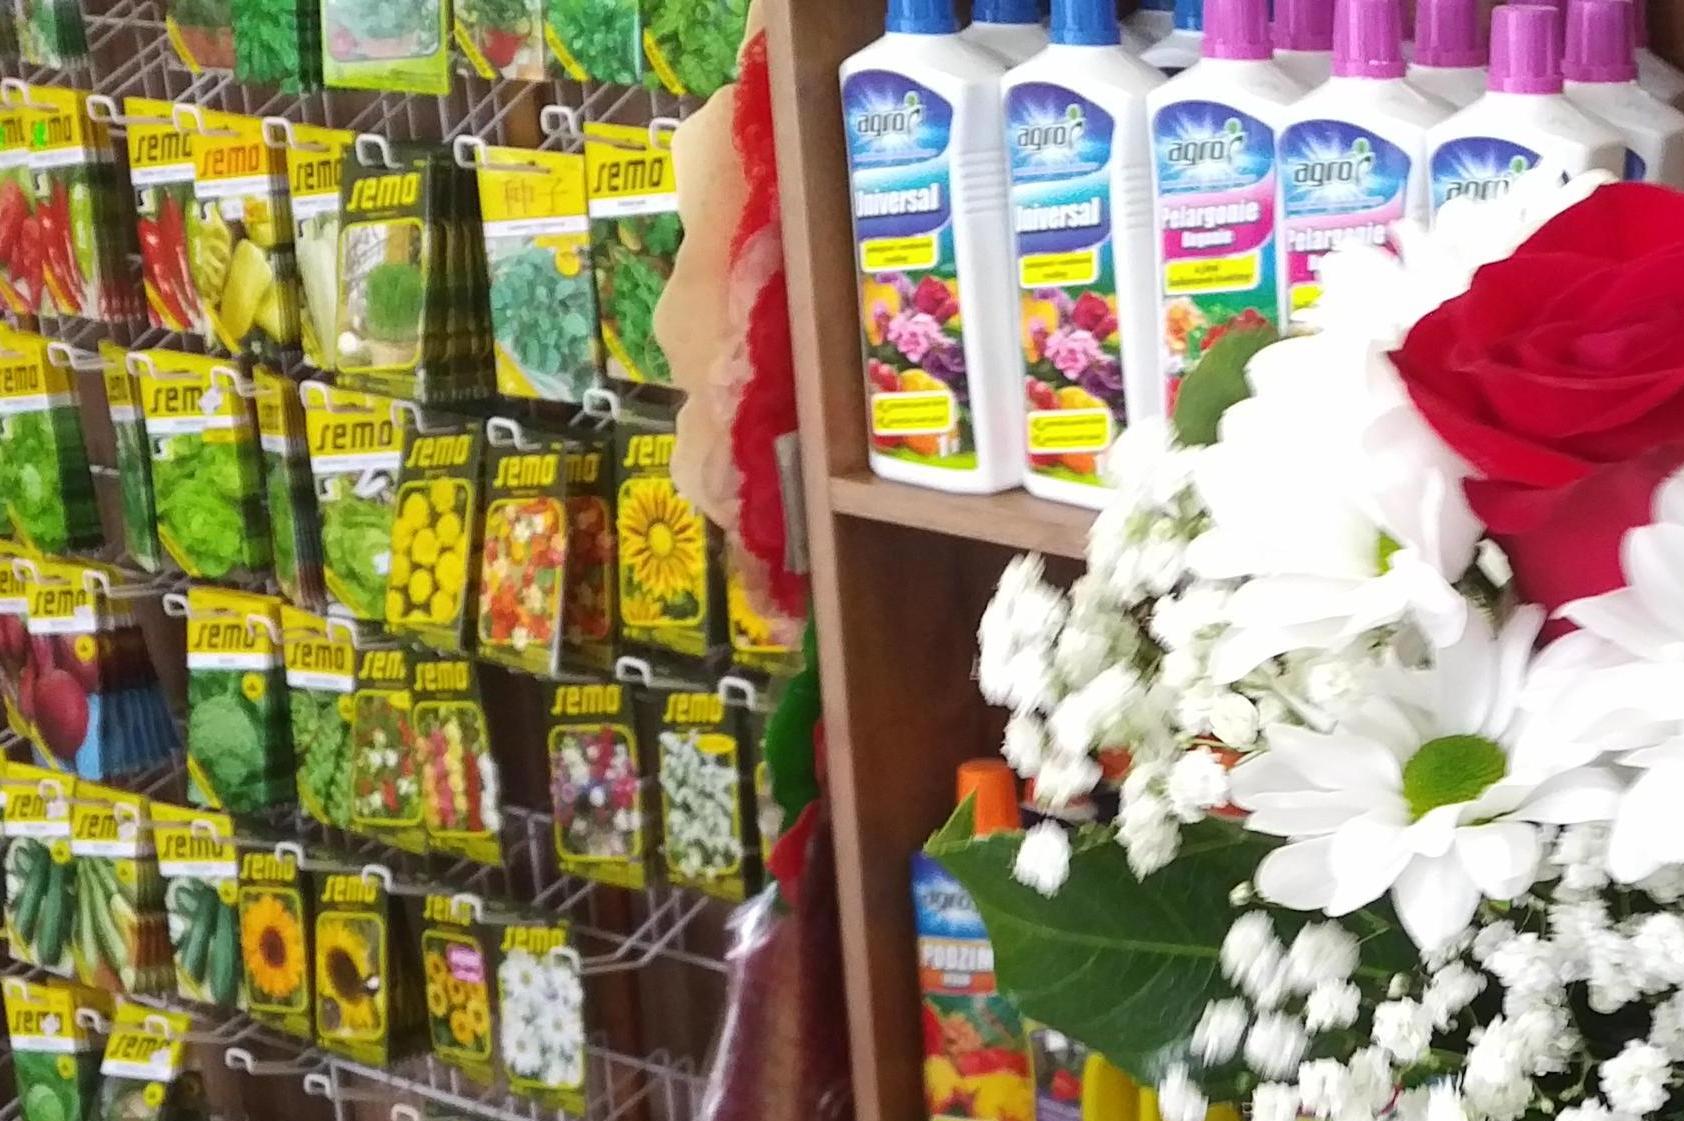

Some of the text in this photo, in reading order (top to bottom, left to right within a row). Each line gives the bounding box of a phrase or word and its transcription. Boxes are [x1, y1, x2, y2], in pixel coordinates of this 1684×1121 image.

[857, 110, 905, 137] agro
[1017, 124, 1066, 151] agro
[200, 144, 261, 177] semo
[1168, 140, 1225, 166] agro
[592, 157, 664, 193] semo
[1294, 161, 1352, 187] agro
[346, 172, 422, 212] semo
[1162, 200, 1260, 229] Pelargonie
[151, 385, 202, 413] sem
[316, 419, 393, 450] semo
[405, 434, 473, 469] semo
[623, 433, 676, 468] sem
[492, 454, 561, 488] semo
[289, 645, 345, 672] semo
[414, 660, 471, 692] semo
[550, 684, 623, 716] semo
[662, 693, 725, 723] semo
[501, 926, 567, 956] semo
